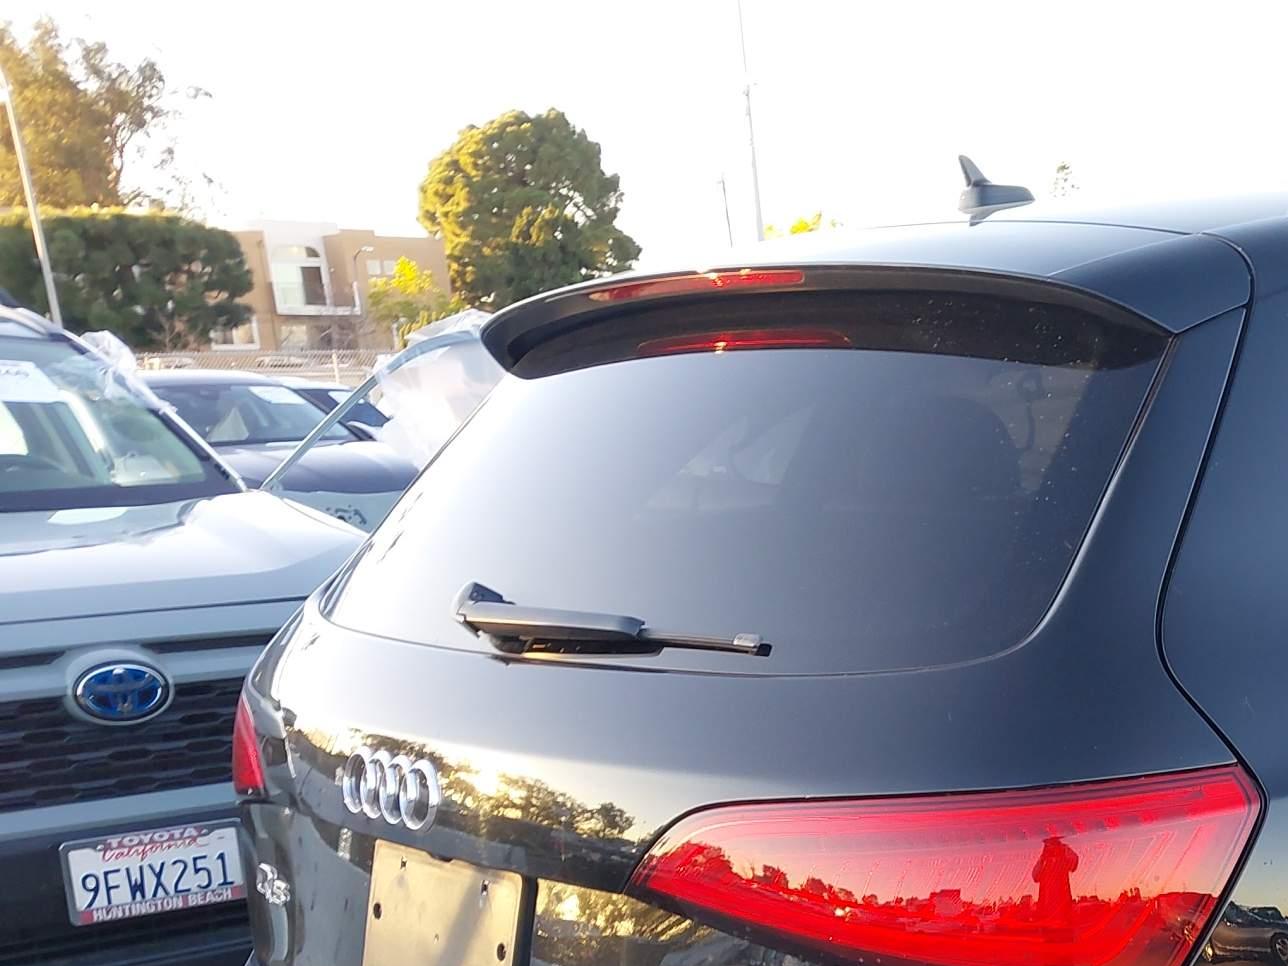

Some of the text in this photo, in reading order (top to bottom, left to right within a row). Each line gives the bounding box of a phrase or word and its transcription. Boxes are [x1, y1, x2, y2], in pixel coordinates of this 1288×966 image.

[102, 837, 197, 862] California
[106, 828, 196, 847] TOYOTA
[80, 852, 235, 910] 9FWX251
[92, 890, 232, 922] HUNTINGTON BEACH
